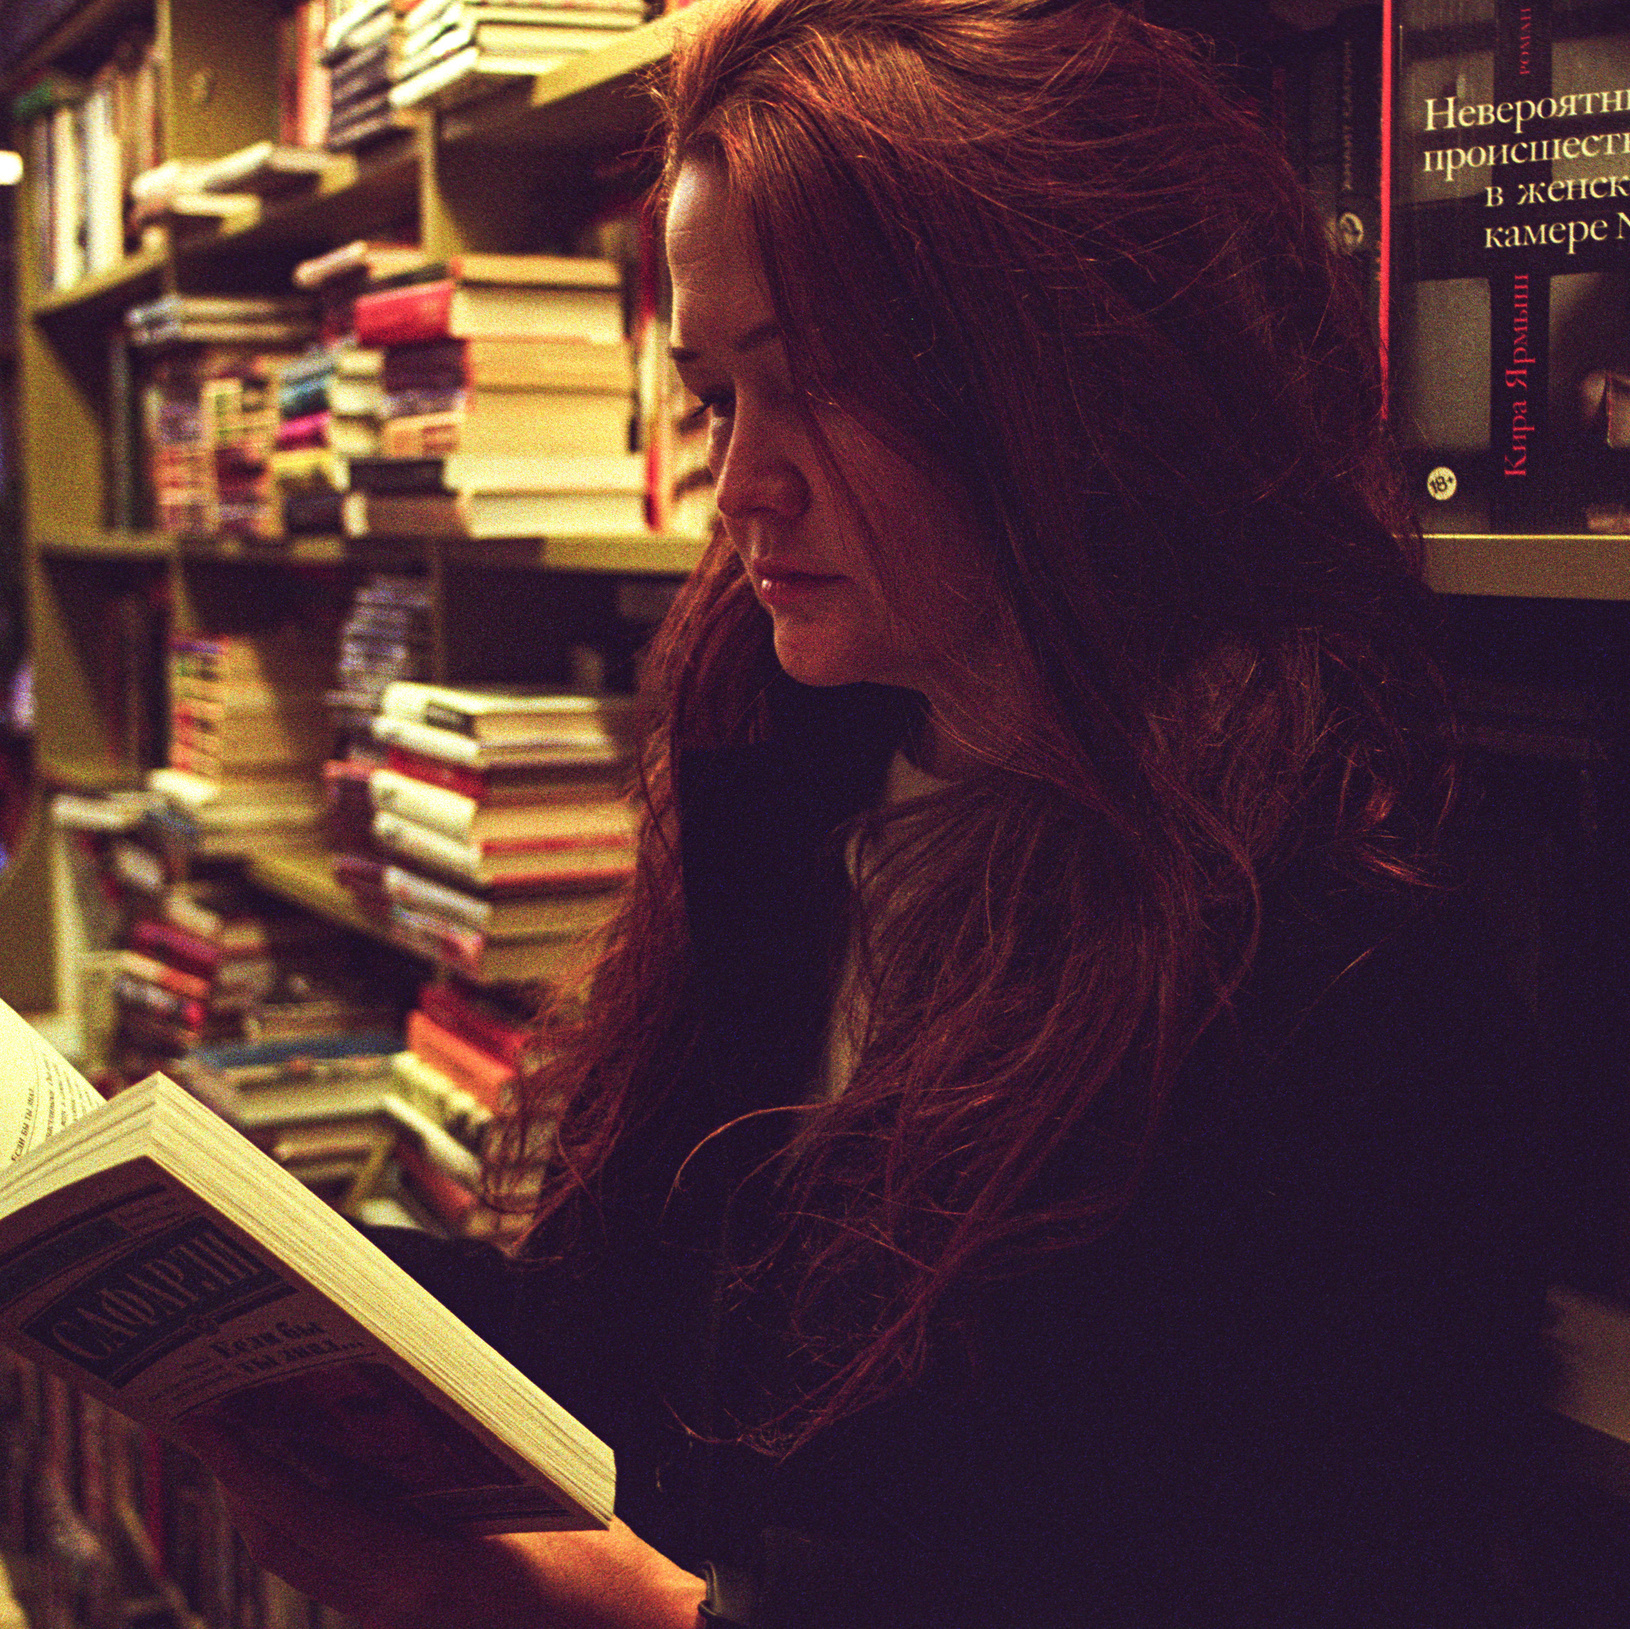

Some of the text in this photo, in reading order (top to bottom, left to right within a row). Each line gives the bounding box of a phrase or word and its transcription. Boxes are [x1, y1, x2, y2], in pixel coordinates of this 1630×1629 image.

[1424, 89, 1630, 134] Невероятн
[1485, 186, 1504, 207] в
[1484, 218, 1608, 255] камере
[1505, 274, 1536, 476] Кира Ярмыш
[1429, 475, 1454, 494] 18+
[53, 1231, 261, 1361] САФАРЛИ
